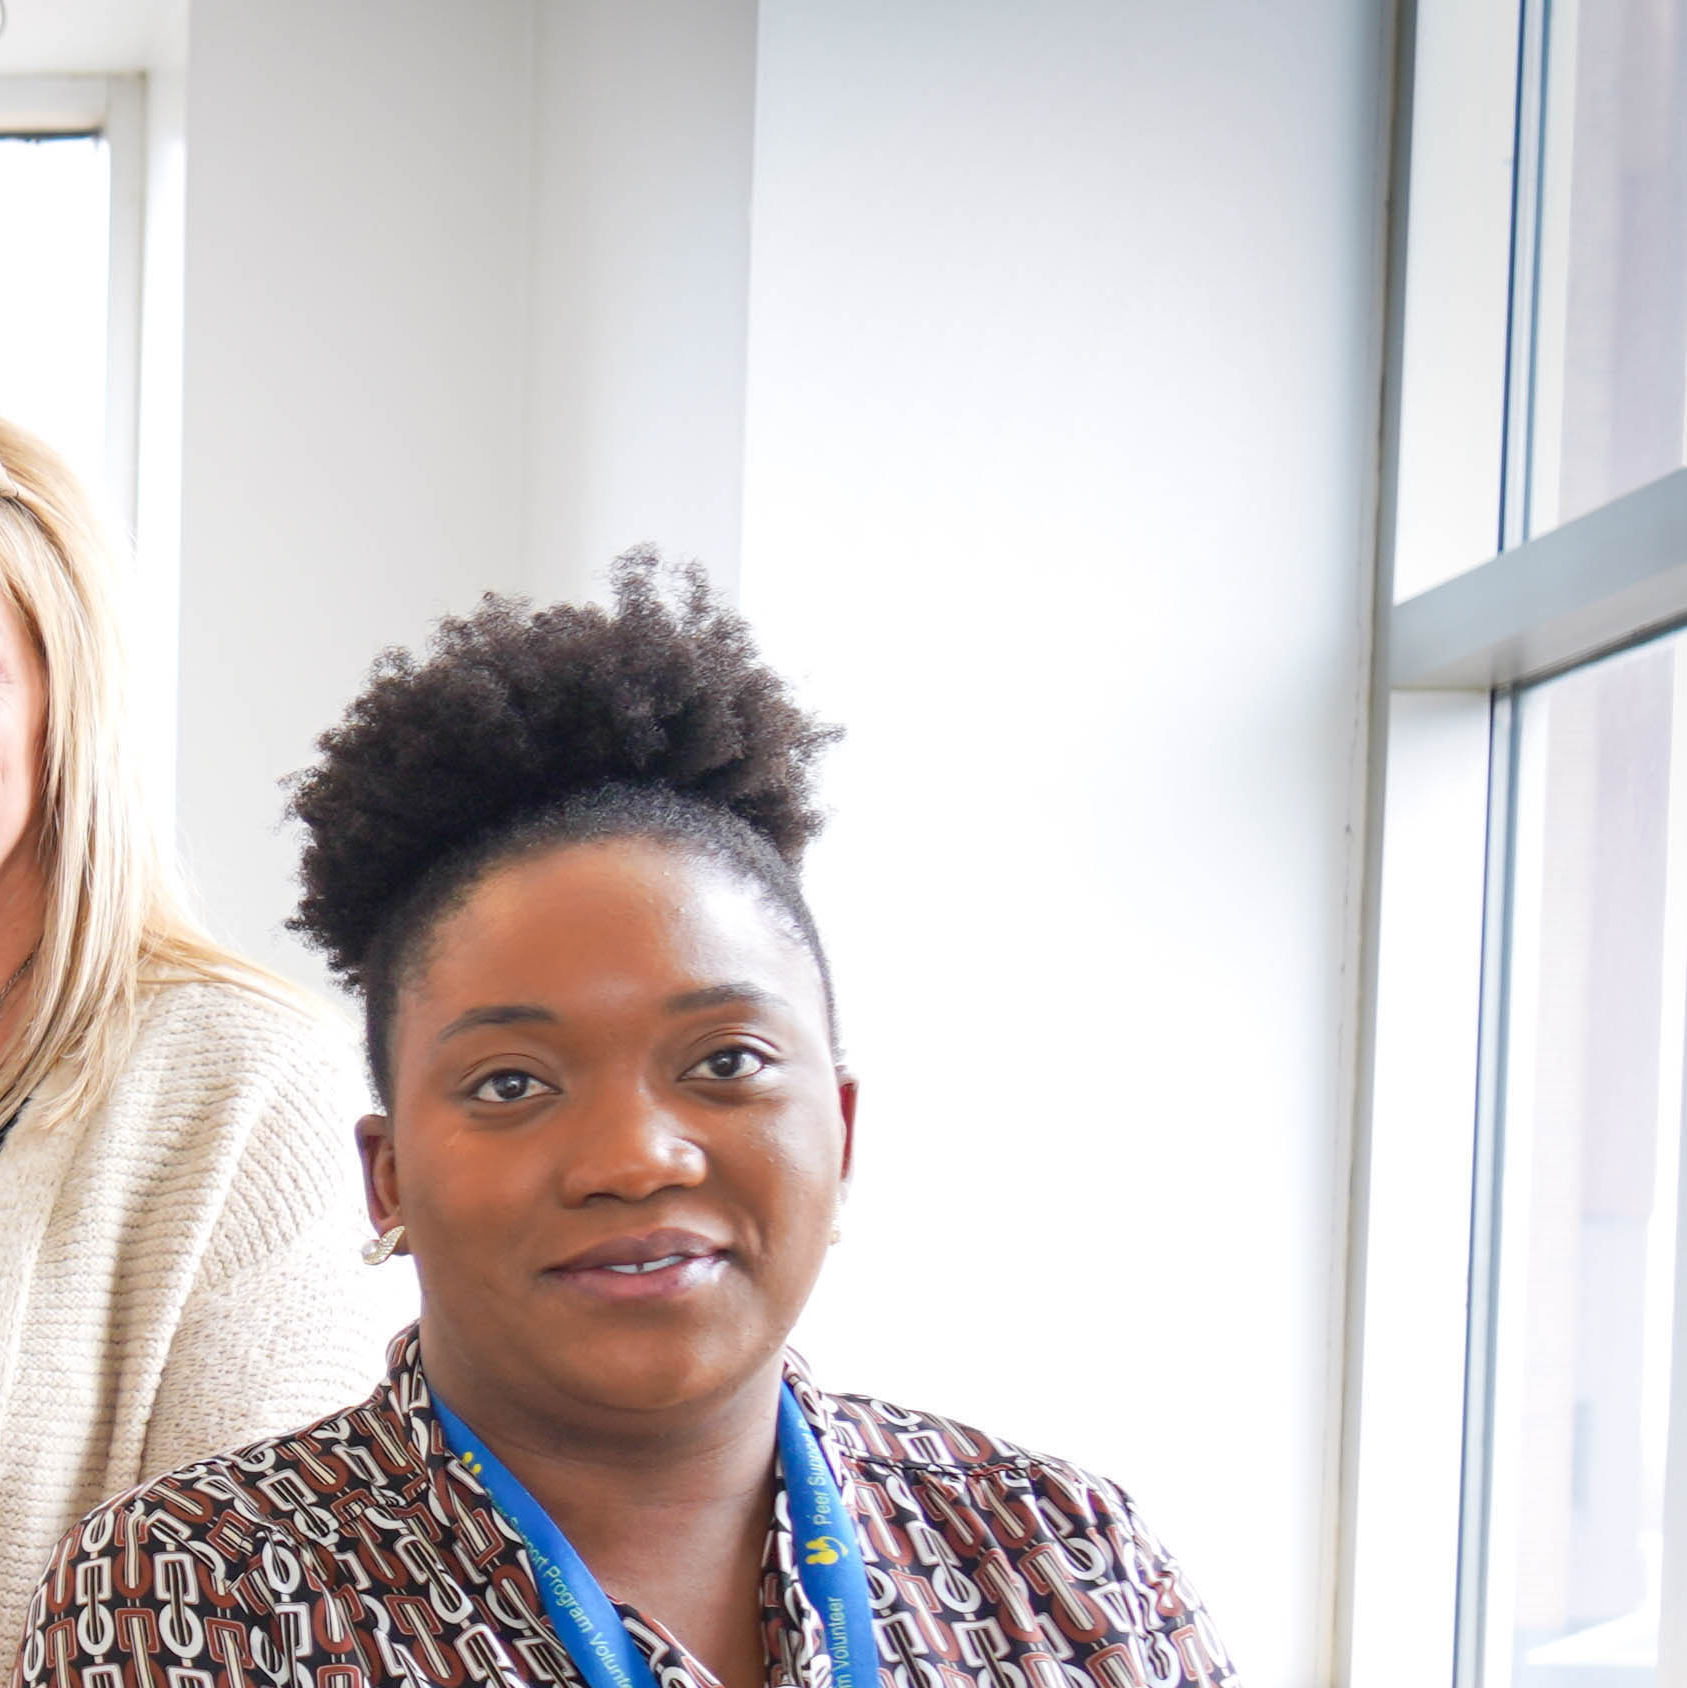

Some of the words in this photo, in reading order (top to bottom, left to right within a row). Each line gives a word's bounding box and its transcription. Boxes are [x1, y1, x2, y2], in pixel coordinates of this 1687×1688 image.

[813, 1491, 833, 1525] Peer
[545, 1566, 594, 1633] Program
[827, 1596, 849, 1671] Volunteer
